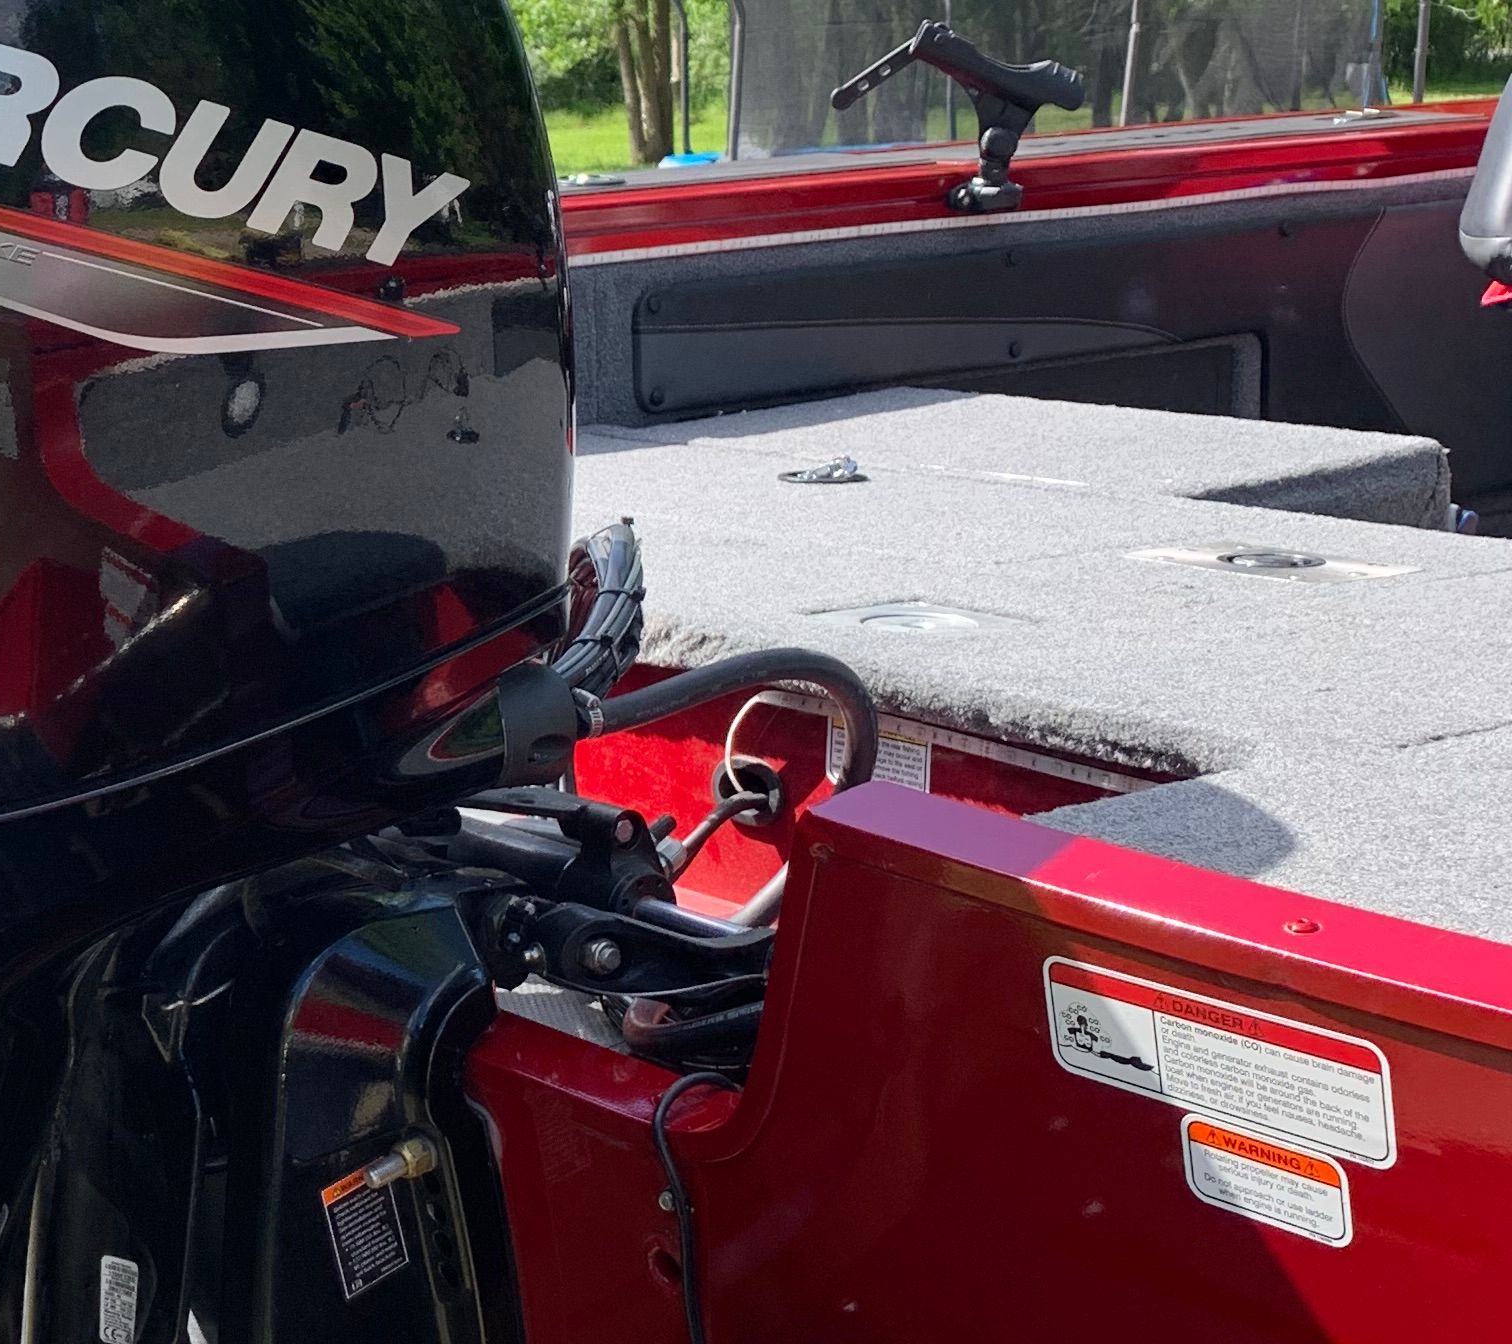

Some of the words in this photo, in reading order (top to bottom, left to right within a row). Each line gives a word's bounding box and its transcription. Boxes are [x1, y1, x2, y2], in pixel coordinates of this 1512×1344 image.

[1161, 1027, 1171, 1035] or
[1173, 1000, 1244, 1031] DANGER
[1160, 1016, 1192, 1032] Carbon
[1194, 1027, 1237, 1045] monoxide
[1240, 1038, 1261, 1054] (CO)
[1264, 1047, 1280, 1057] can
[1283, 1052, 1309, 1065] cause
[1311, 1058, 1334, 1072] brain
[1337, 1065, 1374, 1084] damage
[1162, 1034, 1190, 1050] Engine
[1193, 1045, 1208, 1055] and
[1211, 1050, 1251, 1067] generator
[1254, 1063, 1288, 1078] exhaust
[1291, 1073, 1328, 1090] contains
[1331, 1084, 1370, 1102] odorless
[1163, 1046, 1178, 1056] and
[1181, 1051, 1217, 1067] colorless
[1220, 1062, 1250, 1077] carbon
[1252, 1072, 1295, 1090] monoxide
[1164, 1053, 1194, 1069] Carbon
[1196, 1065, 1238, 1083] monoxide
[1241, 1078, 1254, 1087] will
[1256, 1081, 1267, 1091] be
[1270, 1086, 1300, 1101] around
[1302, 1094, 1317, 1106] the
[1320, 1099, 1341, 1114] back
[1344, 1108, 1353, 1117] of
[1355, 1110, 1369, 1122] the
[1166, 1072, 1188, 1086] Move
[1190, 1079, 1198, 1089] to
[1200, 1082, 1222, 1096] fresh
[1245, 1098, 1261, 1108] you
[1263, 1102, 1279, 1114] feel
[1186, 1070, 1207, 1082] when
[1210, 1078, 1243, 1093] engines
[1246, 1088, 1254, 1097] or
[1257, 1092, 1303, 1112] generators
[1306, 1107, 1320, 1117] are
[1210, 1096, 1218, 1105] or
[1204, 1149, 1238, 1169] Rotating
[1241, 1162, 1279, 1180] propeller
[1281, 1176, 1298, 1189] may
[1302, 1182, 1327, 1196] cause
[1223, 1135, 1300, 1170] WARNING
[1204, 1172, 1216, 1183] Do
[1219, 1179, 1231, 1188] not
[1234, 1184, 1274, 1202] approach
[1276, 1198, 1284, 1206] or
[1288, 1202, 1302, 1212] use
[1306, 1206, 1333, 1222] ladder
[1219, 1164, 1248, 1179] serious
[1251, 1173, 1273, 1190] injury
[1276, 1183, 1284, 1191] or
[1219, 1188, 1240, 1200] when
[1244, 1196, 1272, 1211] engine
[1274, 1205, 1281, 1214] is
